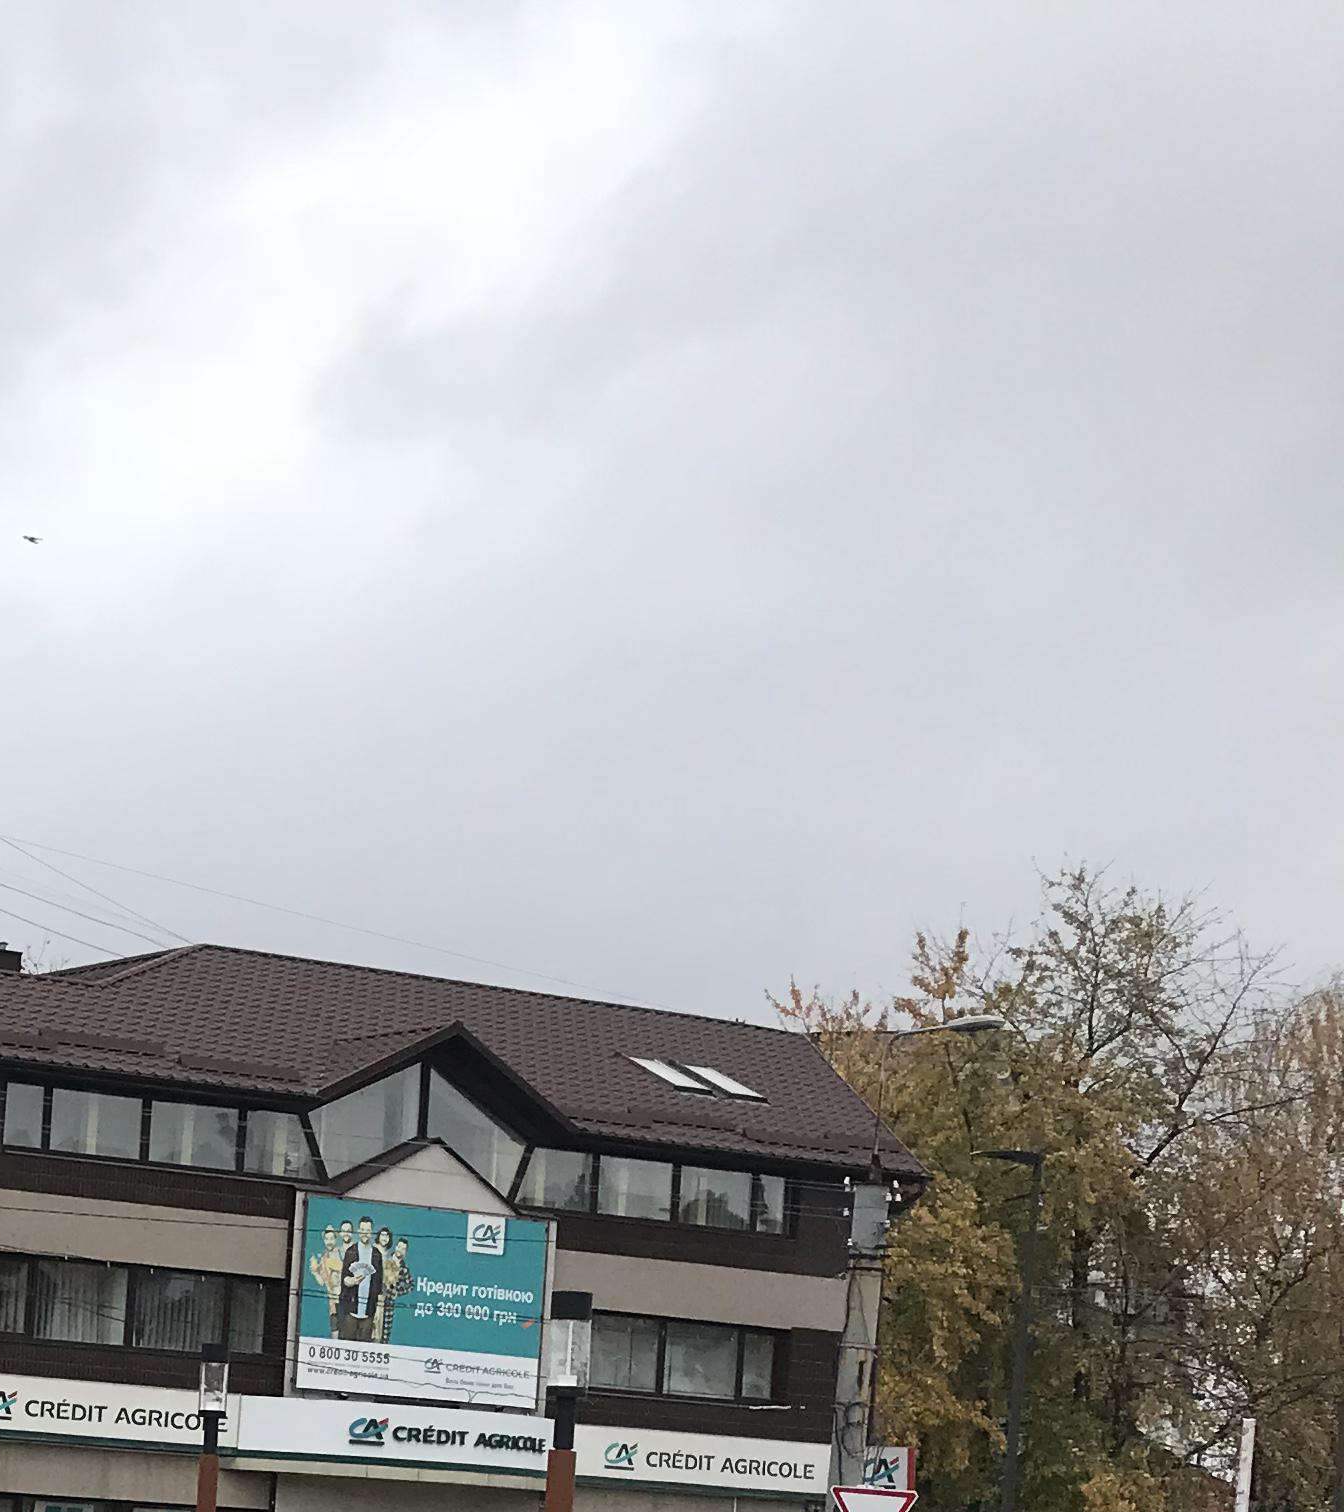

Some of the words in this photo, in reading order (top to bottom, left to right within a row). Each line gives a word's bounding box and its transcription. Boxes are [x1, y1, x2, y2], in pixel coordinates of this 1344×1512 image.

[416, 1277, 469, 1298] Кредит
[471, 1285, 534, 1304] готівкою
[414, 1303, 434, 1317] до
[437, 1302, 462, 1318] 300
[465, 1305, 490, 1321] 000
[493, 1309, 518, 1326] грн
[309, 1346, 316, 1358] 0
[319, 1347, 340, 1360] 800
[344, 1350, 359, 1362] 30
[361, 1352, 390, 1364] 5555
[24, 1399, 108, 1423] CRÉDIT
[115, 1407, 228, 1433] AGRICOE
[392, 1424, 469, 1448] CRÉDIT
[474, 1432, 546, 1453] AGRICOLE
[645, 1449, 715, 1472] CRÉDIT
[720, 1457, 815, 1480] AGRICOLE
